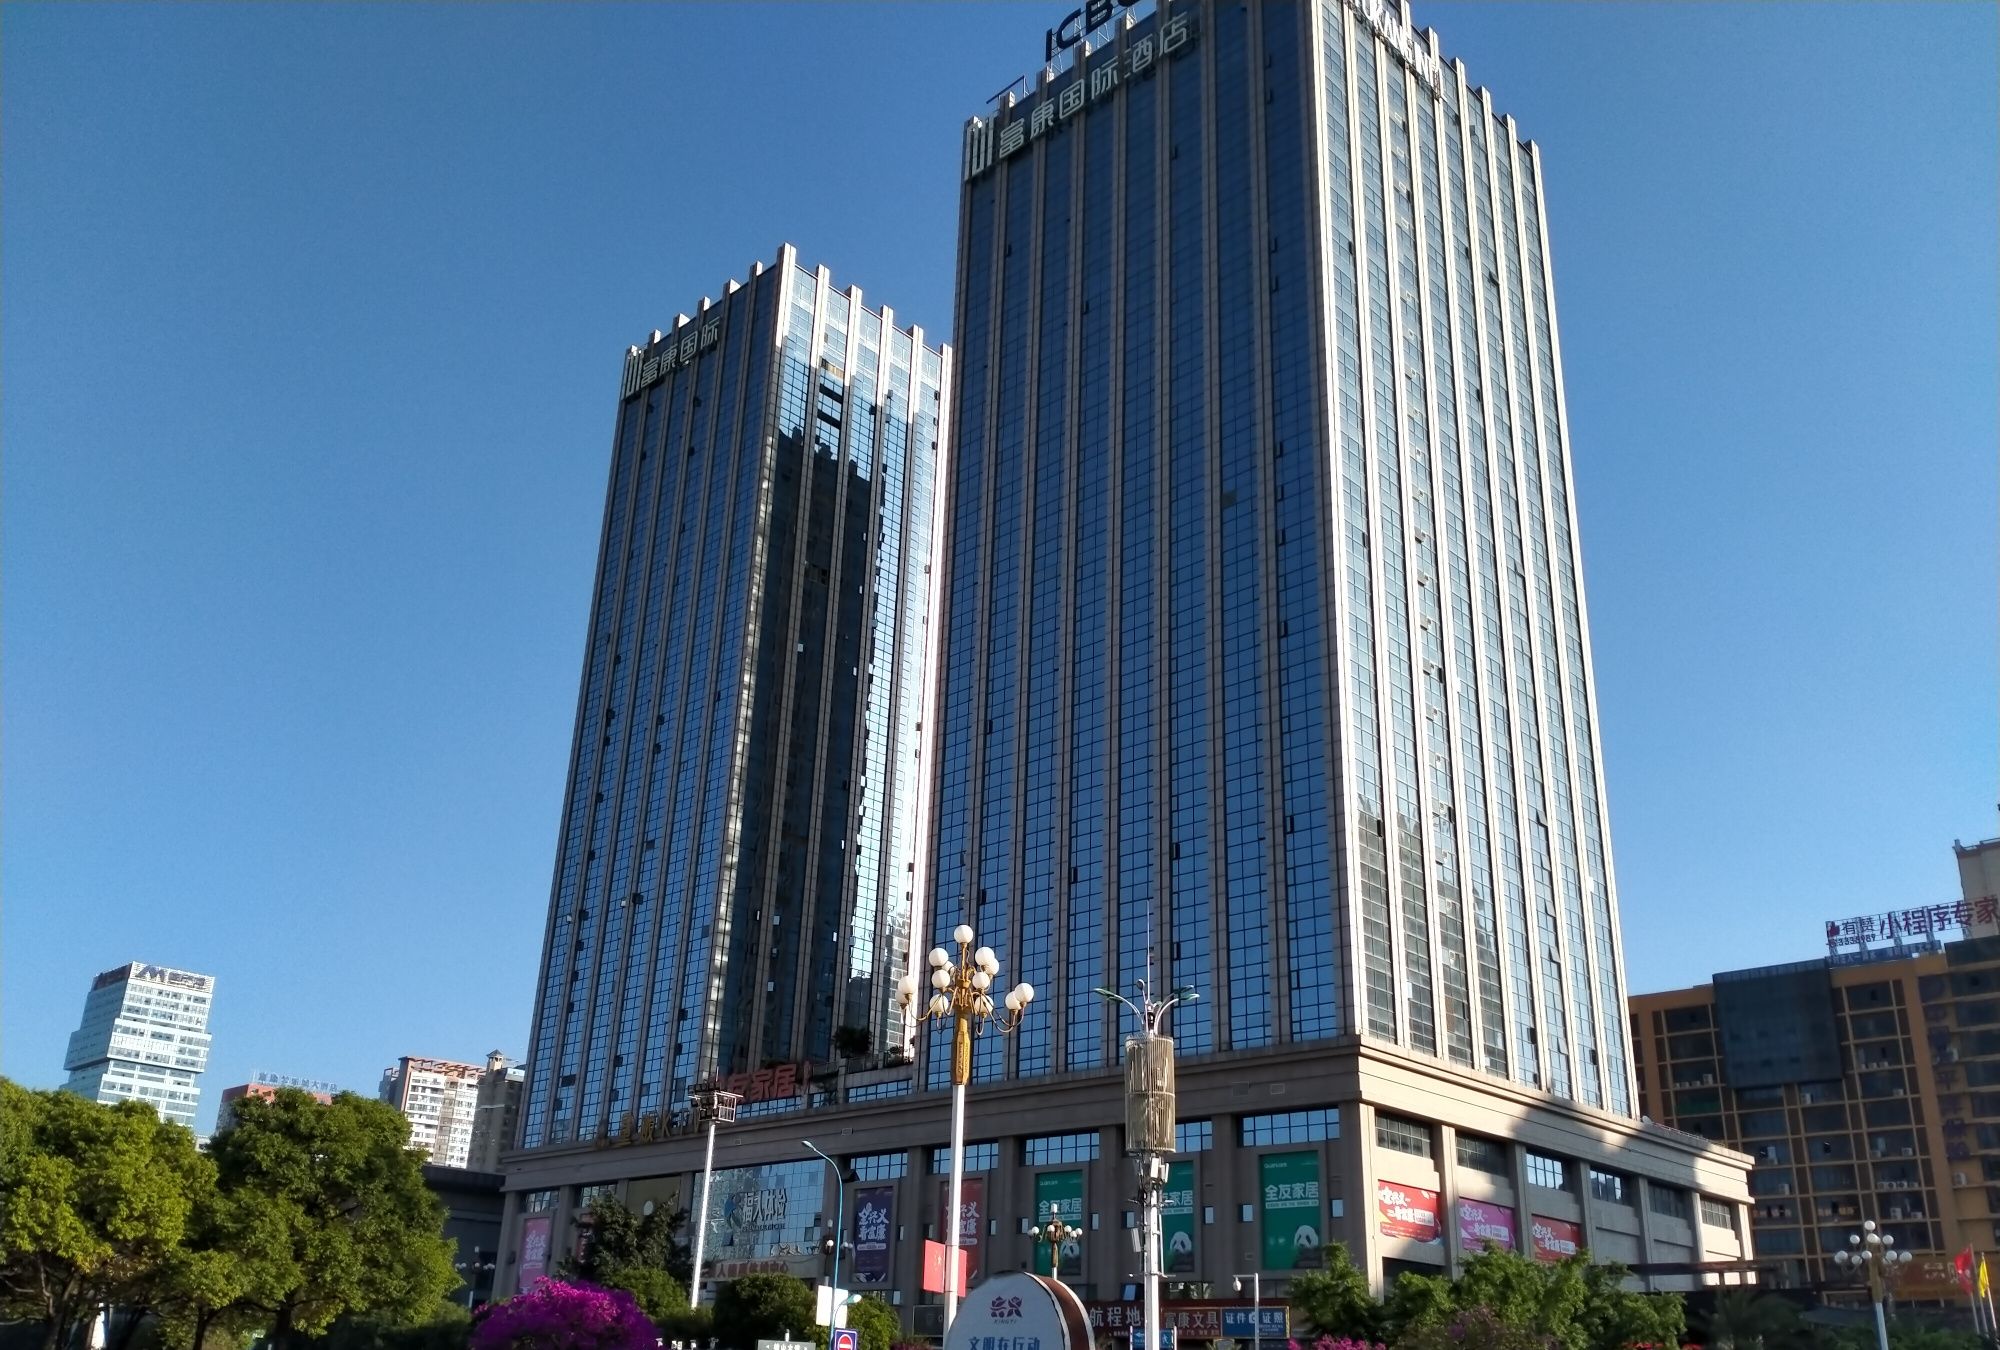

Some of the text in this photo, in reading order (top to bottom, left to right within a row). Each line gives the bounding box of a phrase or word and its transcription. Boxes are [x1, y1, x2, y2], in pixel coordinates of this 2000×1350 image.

[998, 12, 1188, 159] 富康国际酒店
[641, 316, 720, 389] 富康国际
[1880, 896, 1999, 939] 小程序专家
[1265, 1181, 1319, 1201] 全友家居
[1164, 1311, 1219, 1329] 富康文具
[1225, 1311, 1246, 1325] 证件
[968, 1336, 1041, 1350] 文明在行动
